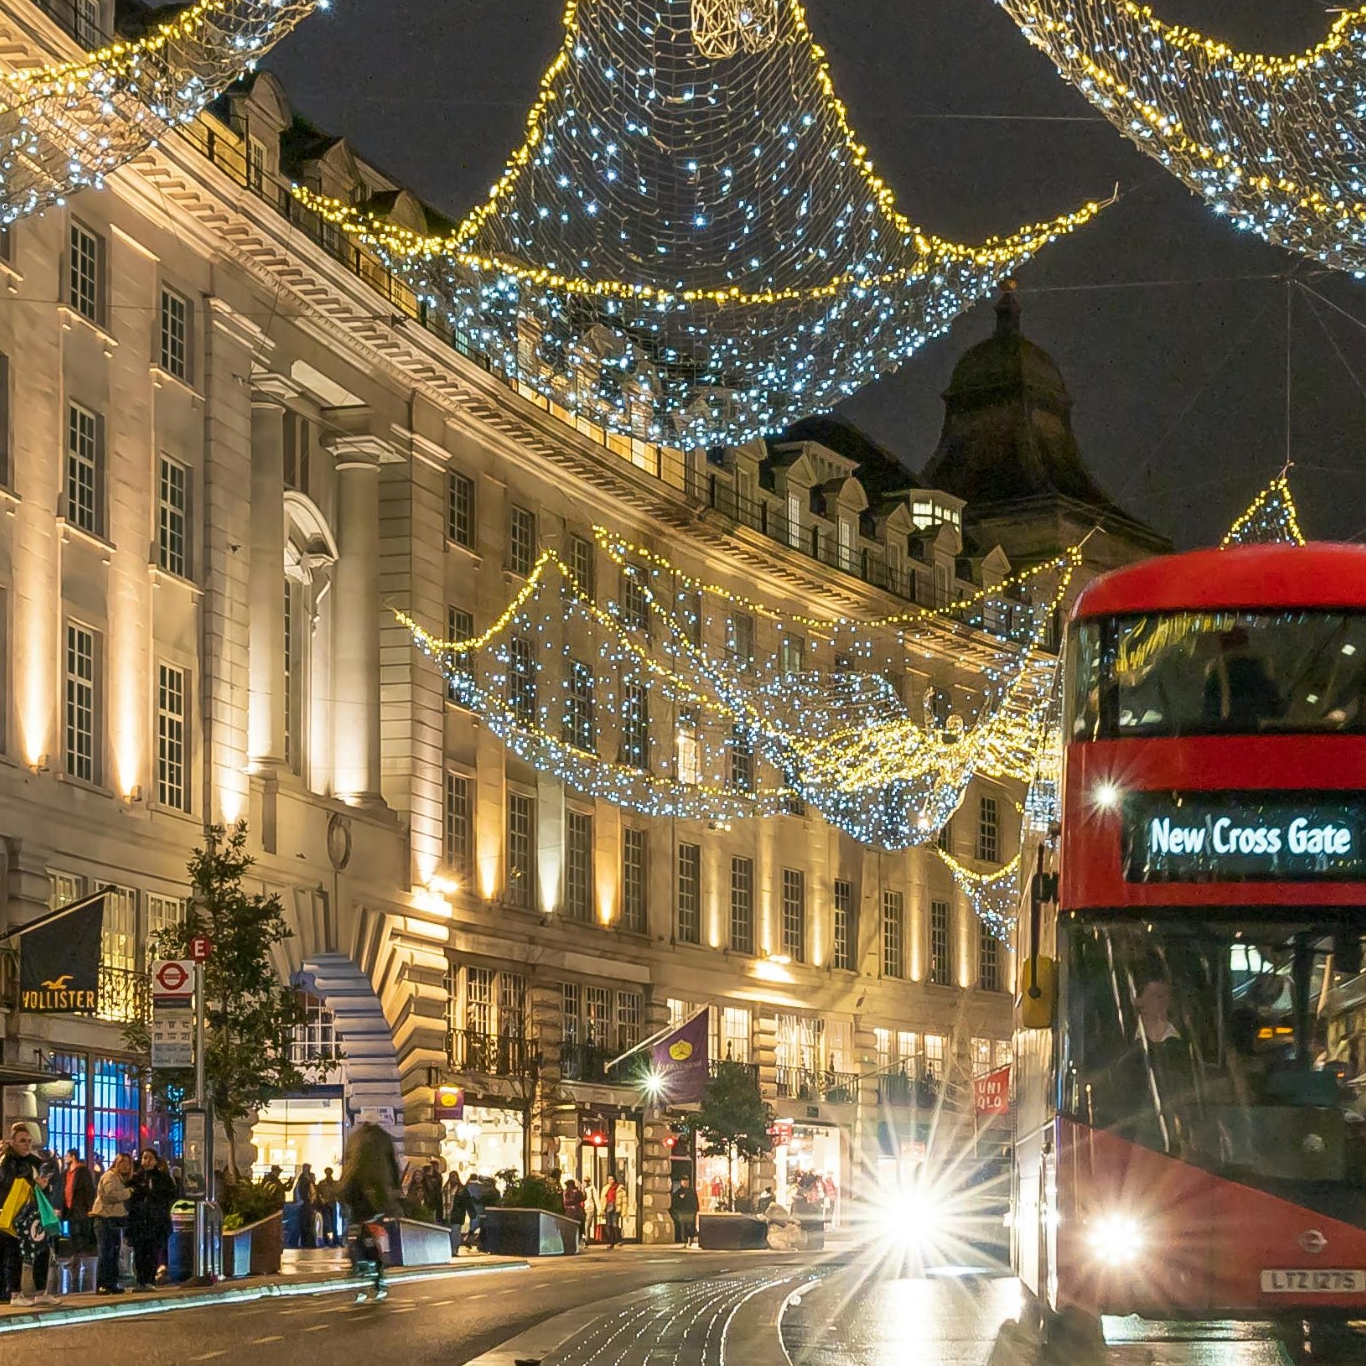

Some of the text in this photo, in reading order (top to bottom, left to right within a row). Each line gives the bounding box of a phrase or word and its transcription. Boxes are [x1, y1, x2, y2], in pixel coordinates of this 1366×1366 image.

[1150, 817, 1351, 854] New Cross Gate
[194, 940, 205, 956] E
[22, 990, 95, 1009] HOLLISTER
[978, 1082, 1001, 1094] UNI
[978, 1096, 1002, 1110] QLO
[1272, 1272, 1308, 1289] LTZ
